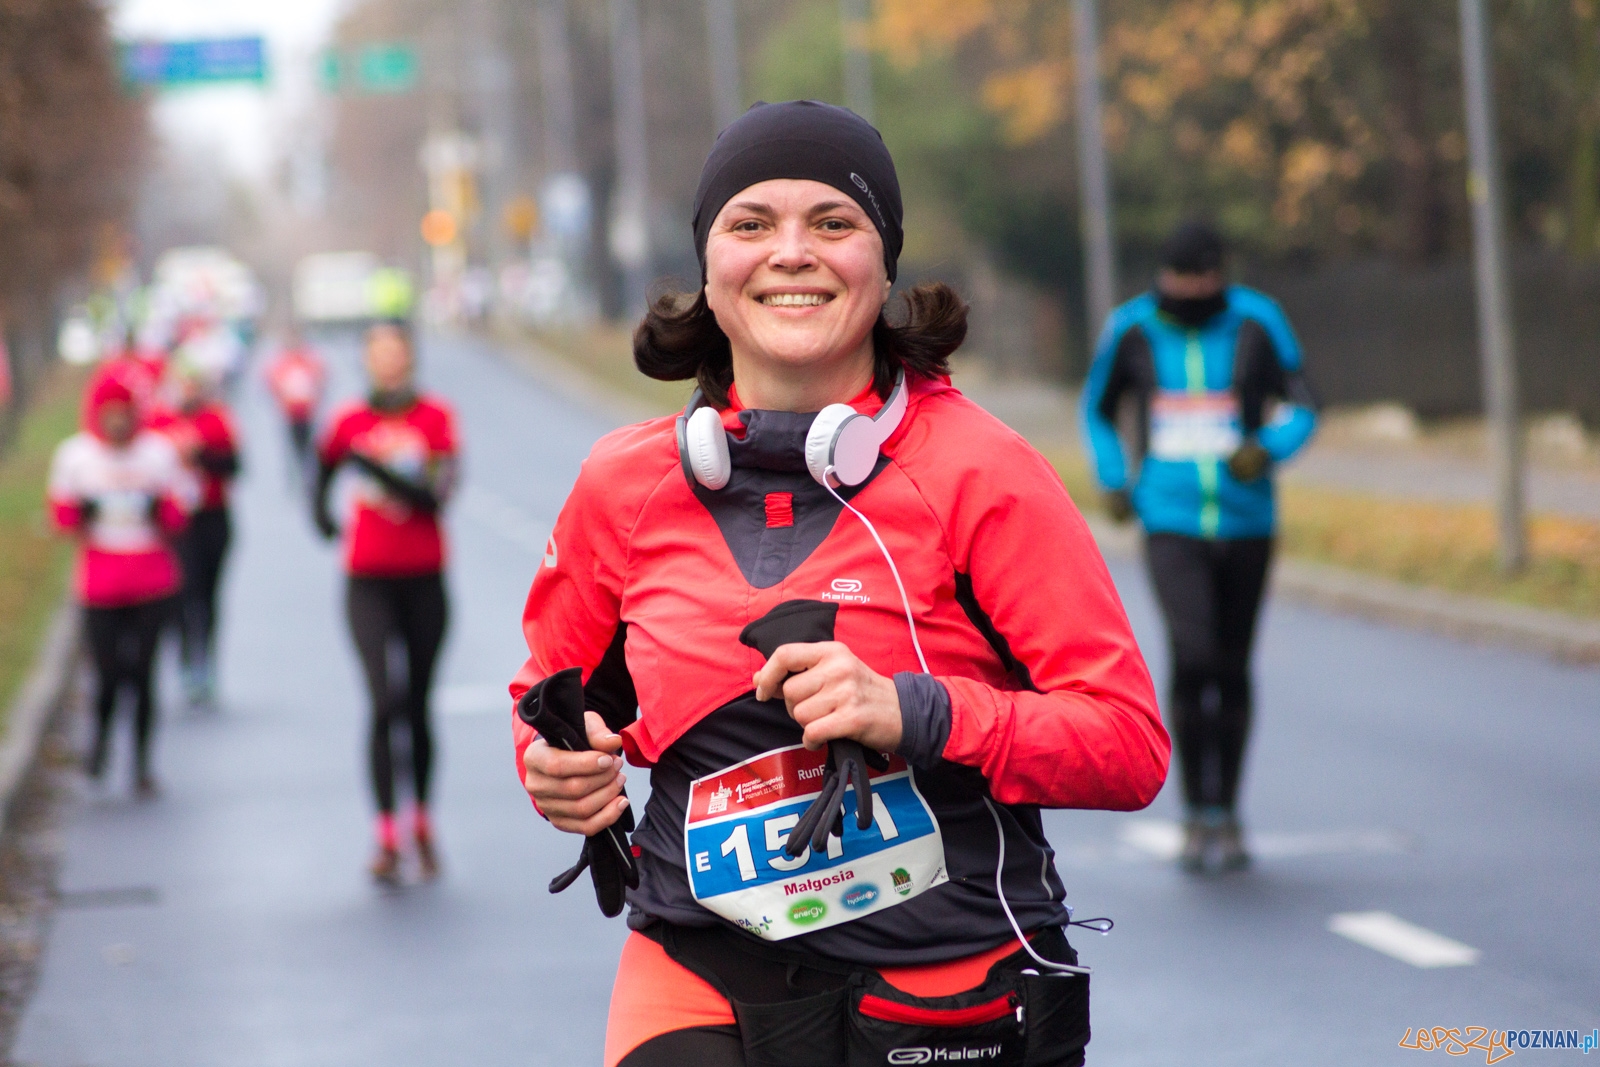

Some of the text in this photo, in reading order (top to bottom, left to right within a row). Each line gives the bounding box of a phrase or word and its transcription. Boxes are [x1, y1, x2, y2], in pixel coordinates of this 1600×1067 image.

[821, 592, 871, 604] Kalenji
[695, 851, 712, 873] E
[783, 870, 855, 896] Małgosia
[934, 1042, 1002, 1061] Kalenji
